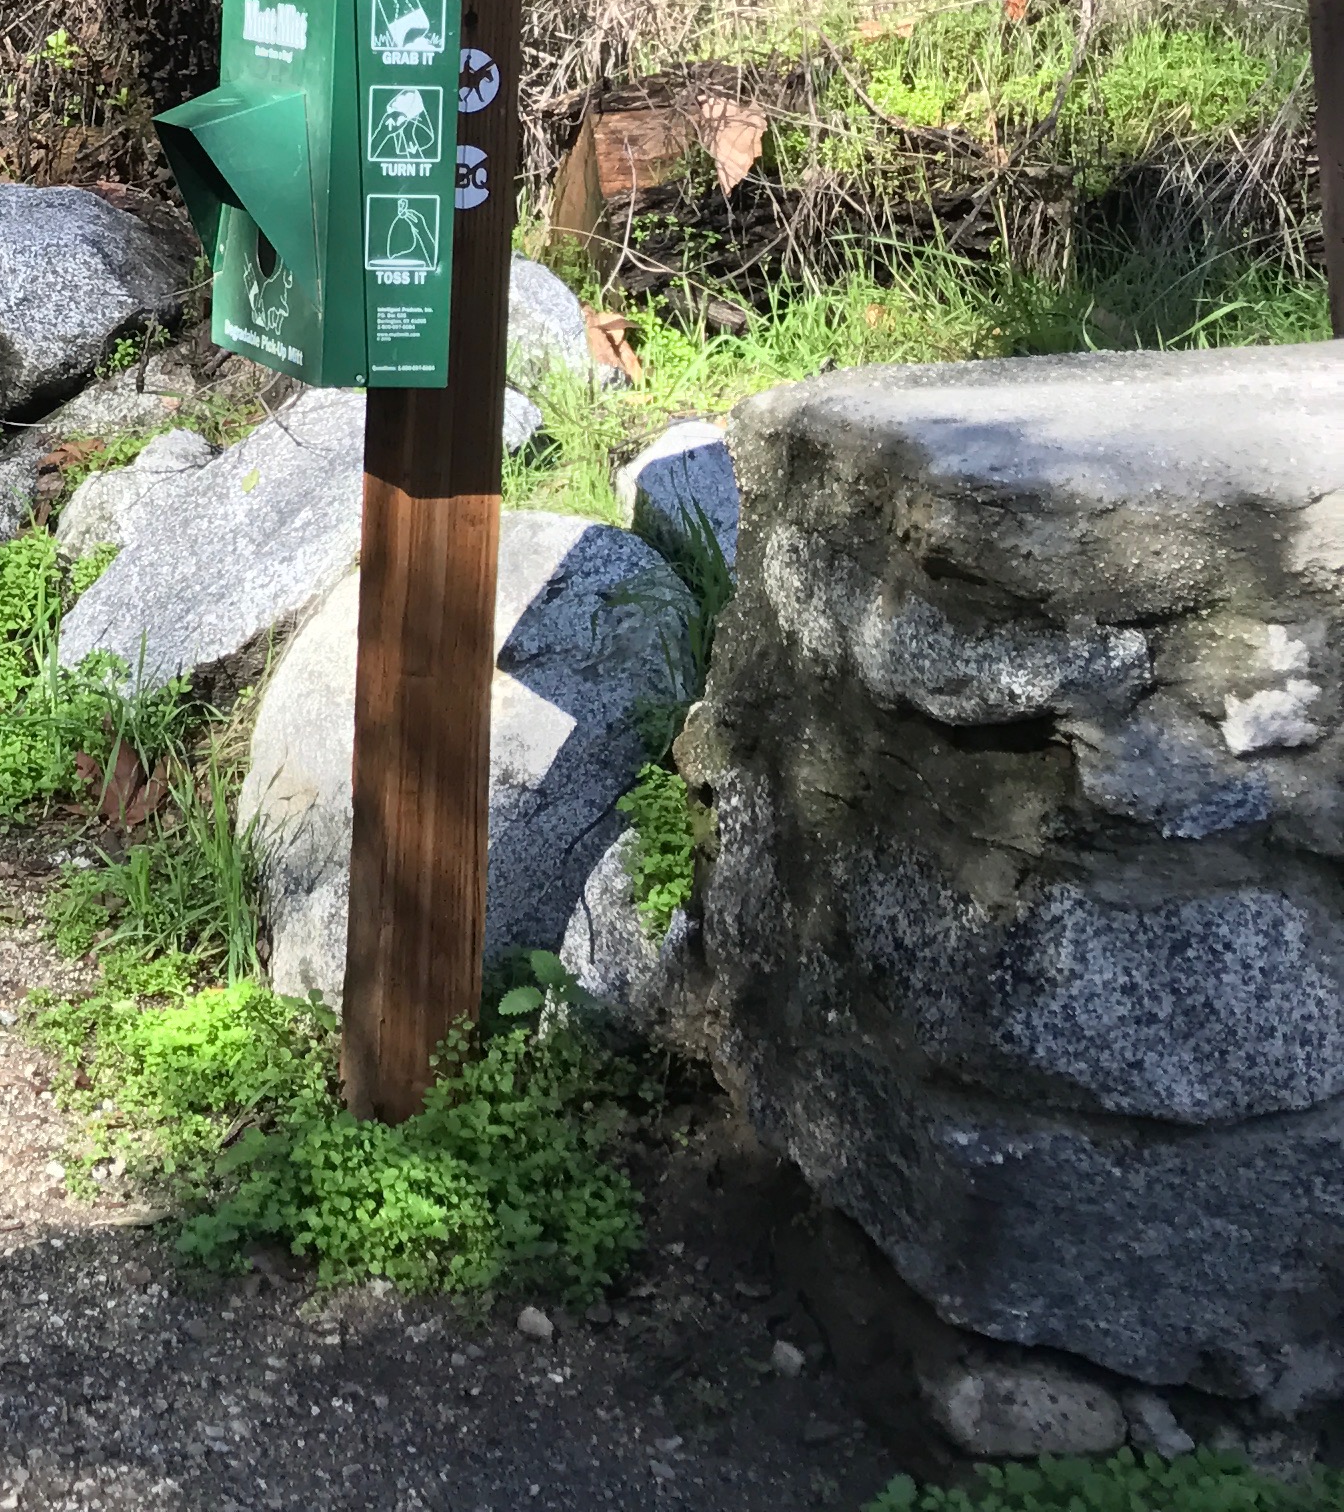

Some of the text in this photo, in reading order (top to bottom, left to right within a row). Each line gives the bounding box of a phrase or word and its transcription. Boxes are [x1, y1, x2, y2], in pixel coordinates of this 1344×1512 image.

[382, 51, 435, 65] GRAB IT
[380, 163, 432, 177] TURN IT
[455, 162, 488, 189] BQ
[376, 271, 427, 285] TOSS IT
[224, 319, 303, 366] Degradable Pick-Up Mitt
